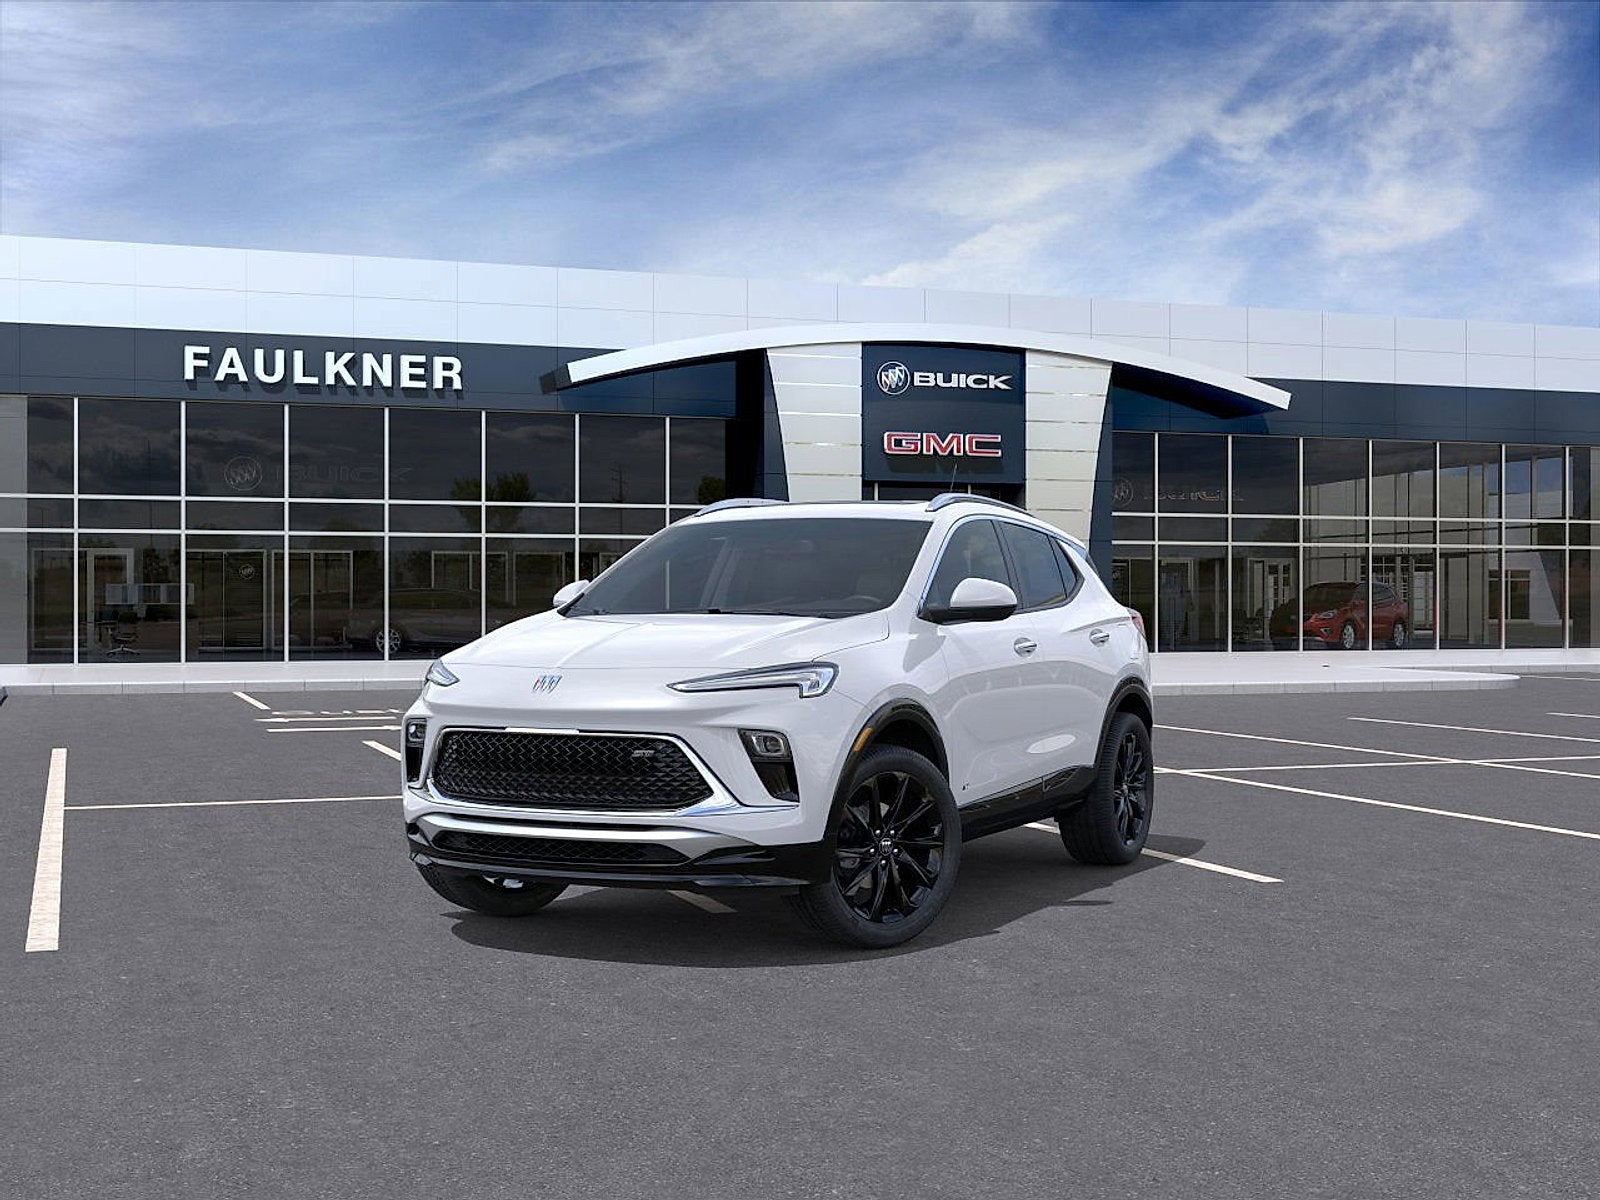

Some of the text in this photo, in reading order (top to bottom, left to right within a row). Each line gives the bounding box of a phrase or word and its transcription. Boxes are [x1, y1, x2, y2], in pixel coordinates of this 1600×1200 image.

[183, 344, 463, 391] FAULKNER
[913, 371, 1013, 390] BUICK
[883, 431, 1002, 458] GMC
